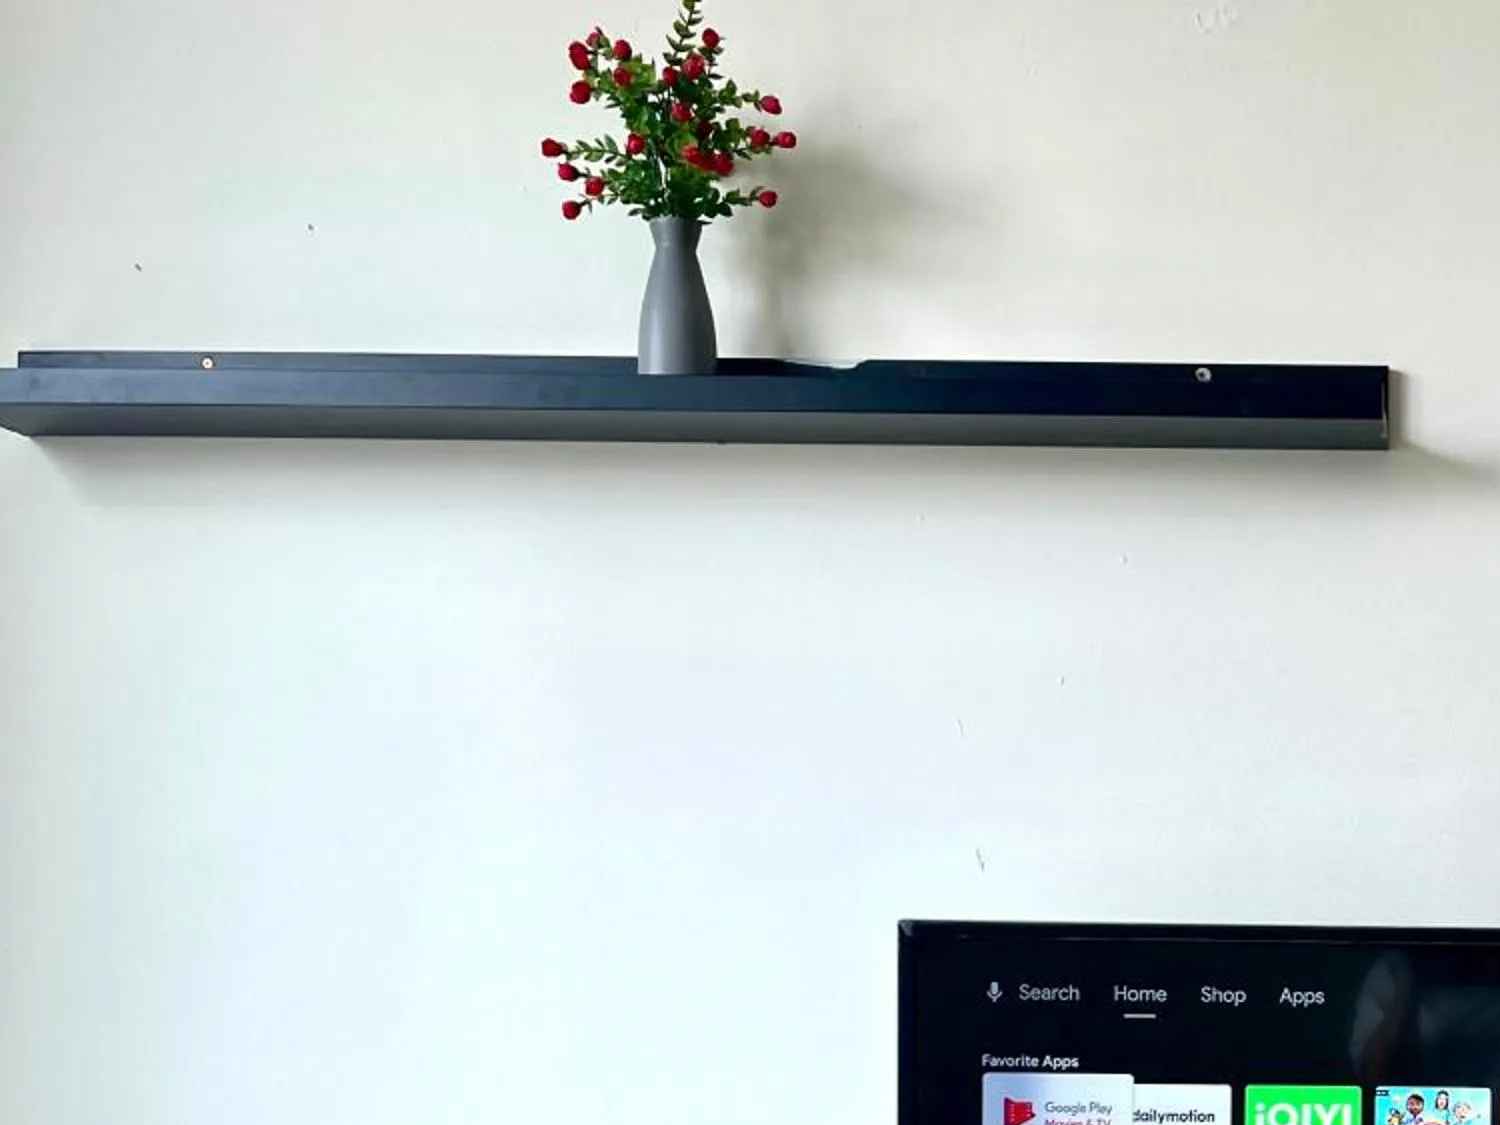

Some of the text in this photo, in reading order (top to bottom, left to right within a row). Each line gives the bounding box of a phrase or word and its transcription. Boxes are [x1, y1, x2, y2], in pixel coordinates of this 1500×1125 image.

[1018, 983, 1080, 1001] Search
[1113, 985, 1168, 1002] Home
[1200, 986, 1246, 1006] Shop
[1279, 987, 1325, 1007] Apps
[981, 1053, 1079, 1070] Favorite Apps
[1044, 1102, 1113, 1115] Google Play
